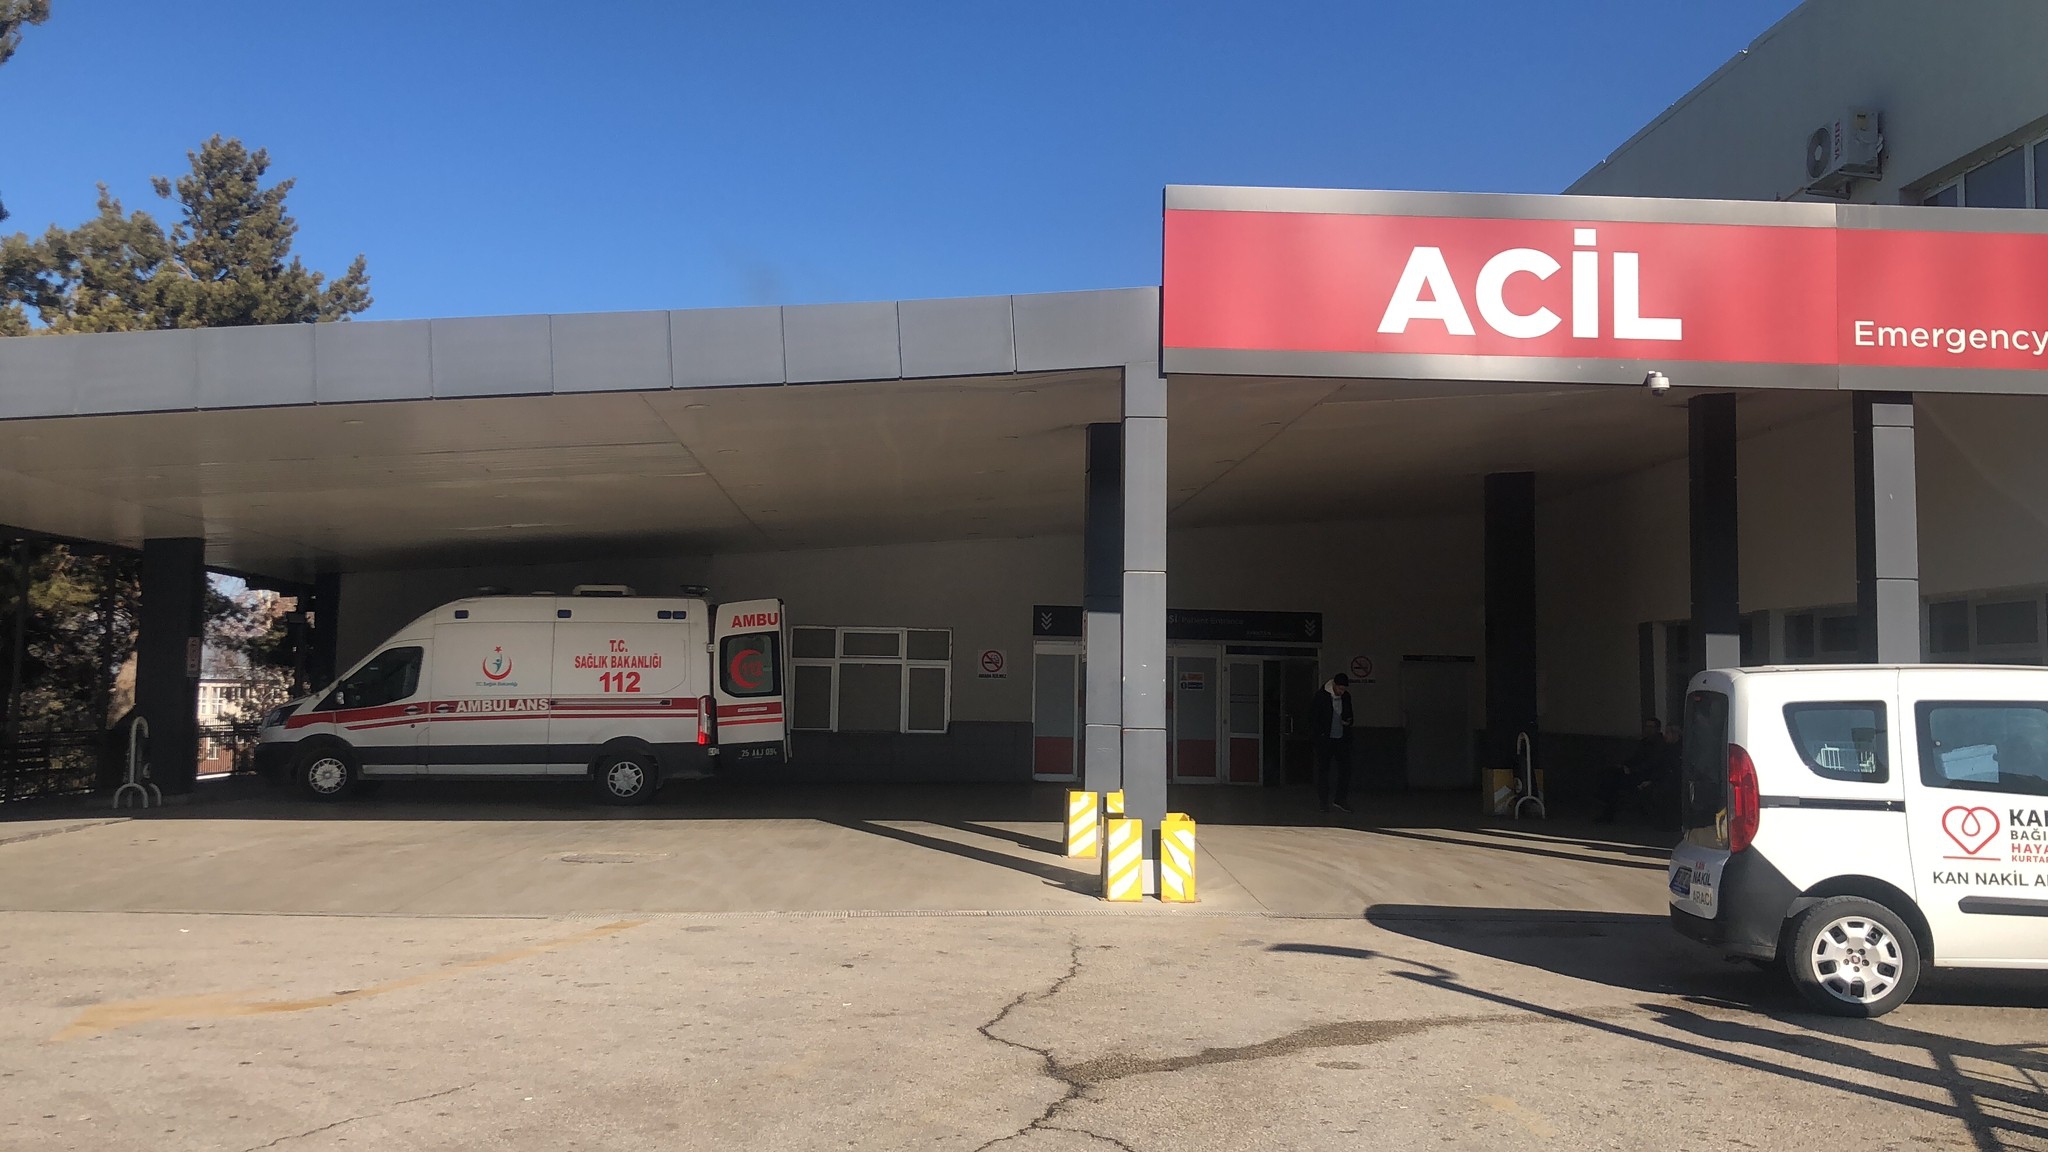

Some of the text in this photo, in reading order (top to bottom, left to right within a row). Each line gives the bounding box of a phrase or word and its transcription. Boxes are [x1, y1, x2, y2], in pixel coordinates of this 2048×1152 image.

[1376, 228, 1683, 341] ACİL
[1854, 320, 2048, 356] Emergency
[731, 612, 779, 628] AMBU
[609, 639, 628, 652] T.C.
[574, 653, 662, 669] SAĞLIK BAKANLIĞI
[599, 671, 641, 693] 112
[455, 698, 549, 713] AMBULANS
[2009, 809, 2048, 827] KA
[1693, 870, 1711, 886] NAKİL
[1933, 870, 2048, 887] KAN NAKİL A
[1693, 890, 1712, 906] ARACI
